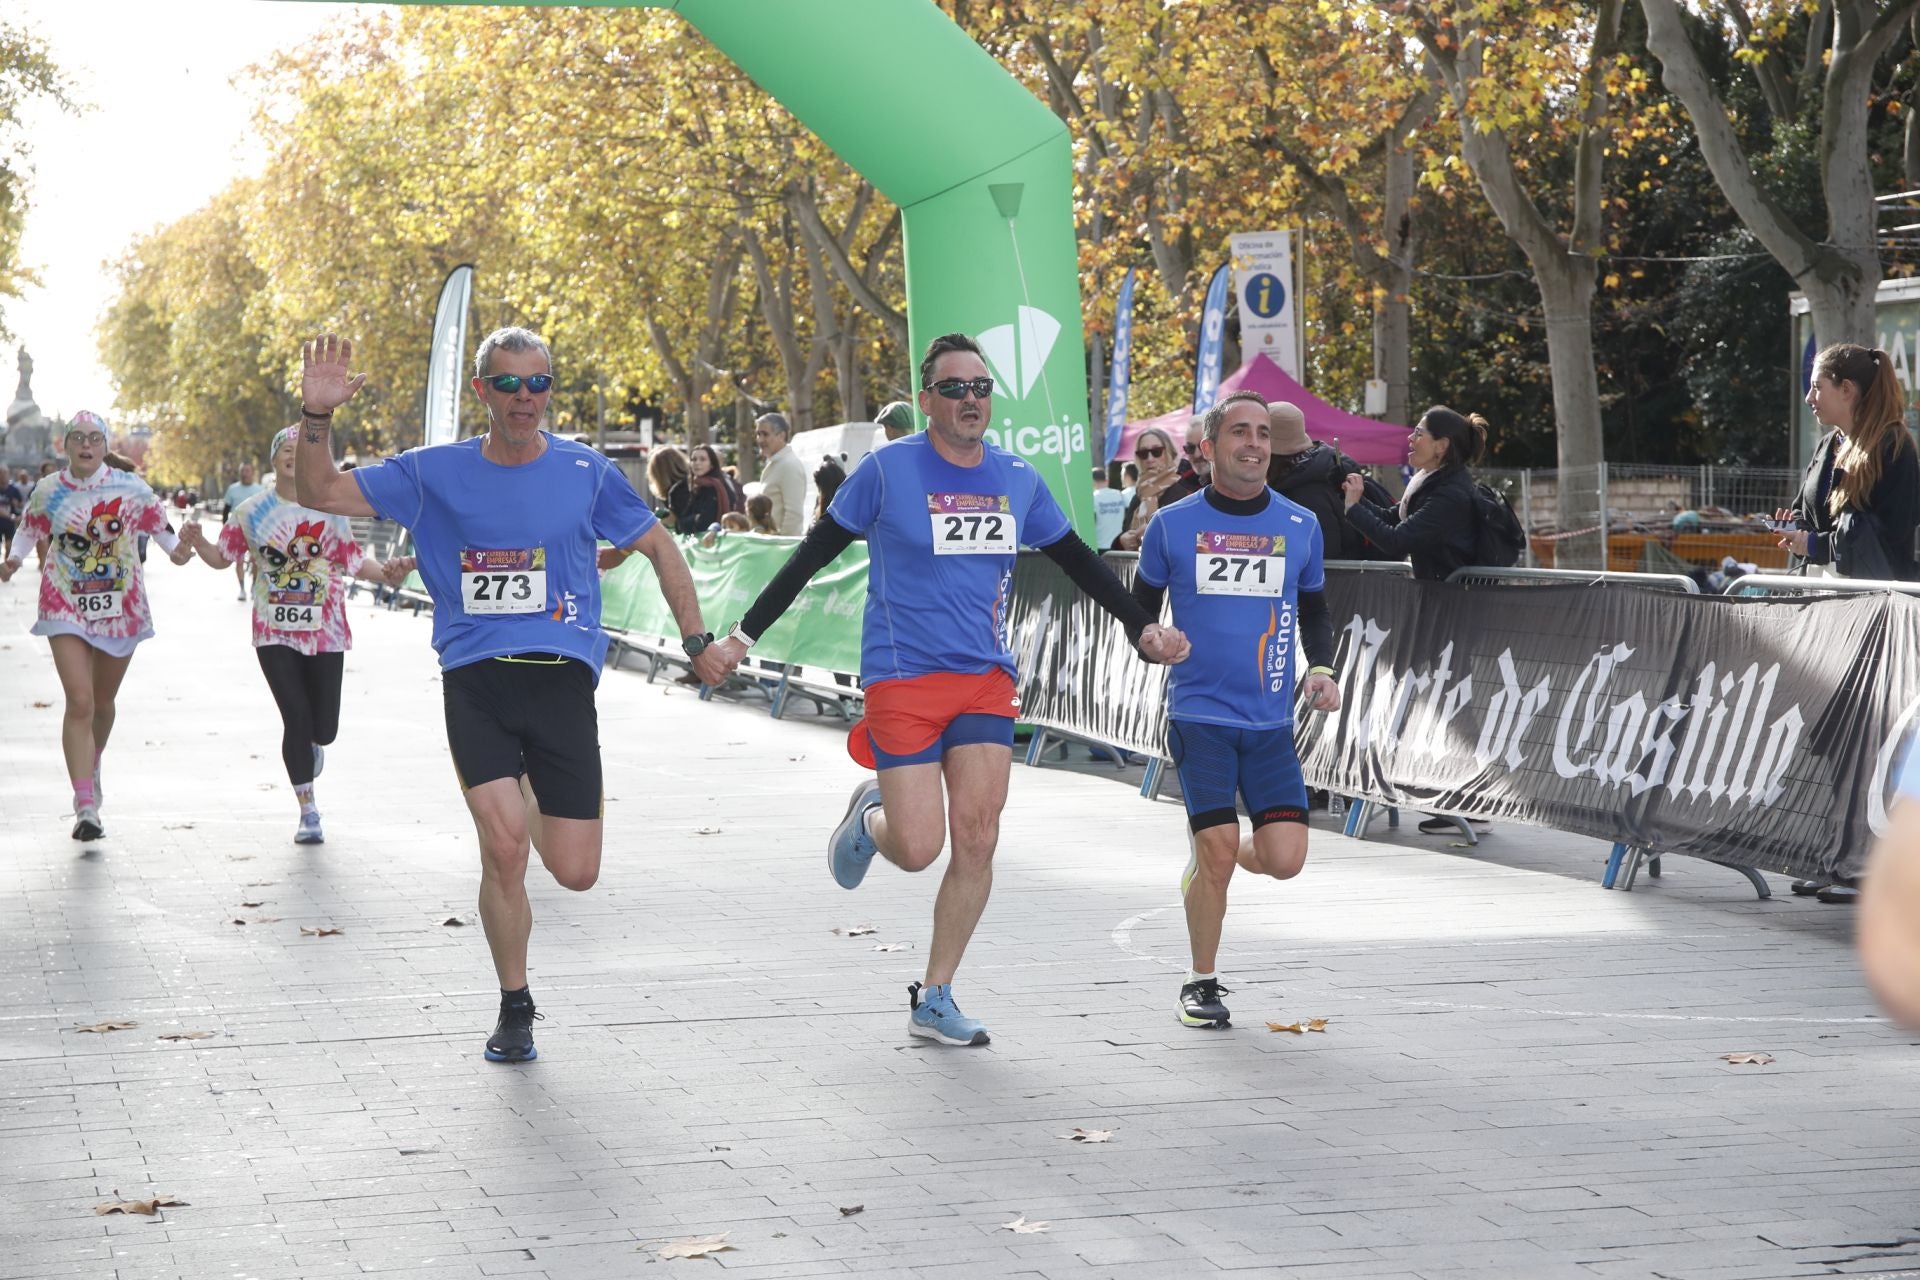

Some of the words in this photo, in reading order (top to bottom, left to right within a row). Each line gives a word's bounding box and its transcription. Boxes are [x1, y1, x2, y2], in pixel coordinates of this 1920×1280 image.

[982, 414, 1085, 465] nicaja
[944, 515, 1004, 541] 272
[1225, 540, 1258, 549] EMPRESAS
[1208, 556, 1267, 584] 271
[472, 574, 532, 601] 273
[78, 594, 112, 612] 863
[275, 606, 313, 623] 864
[1270, 600, 1292, 693] elecnor
[1323, 613, 1473, 762] Norte
[1474, 648, 1551, 773] de
[1552, 641, 1806, 810] Castilla
